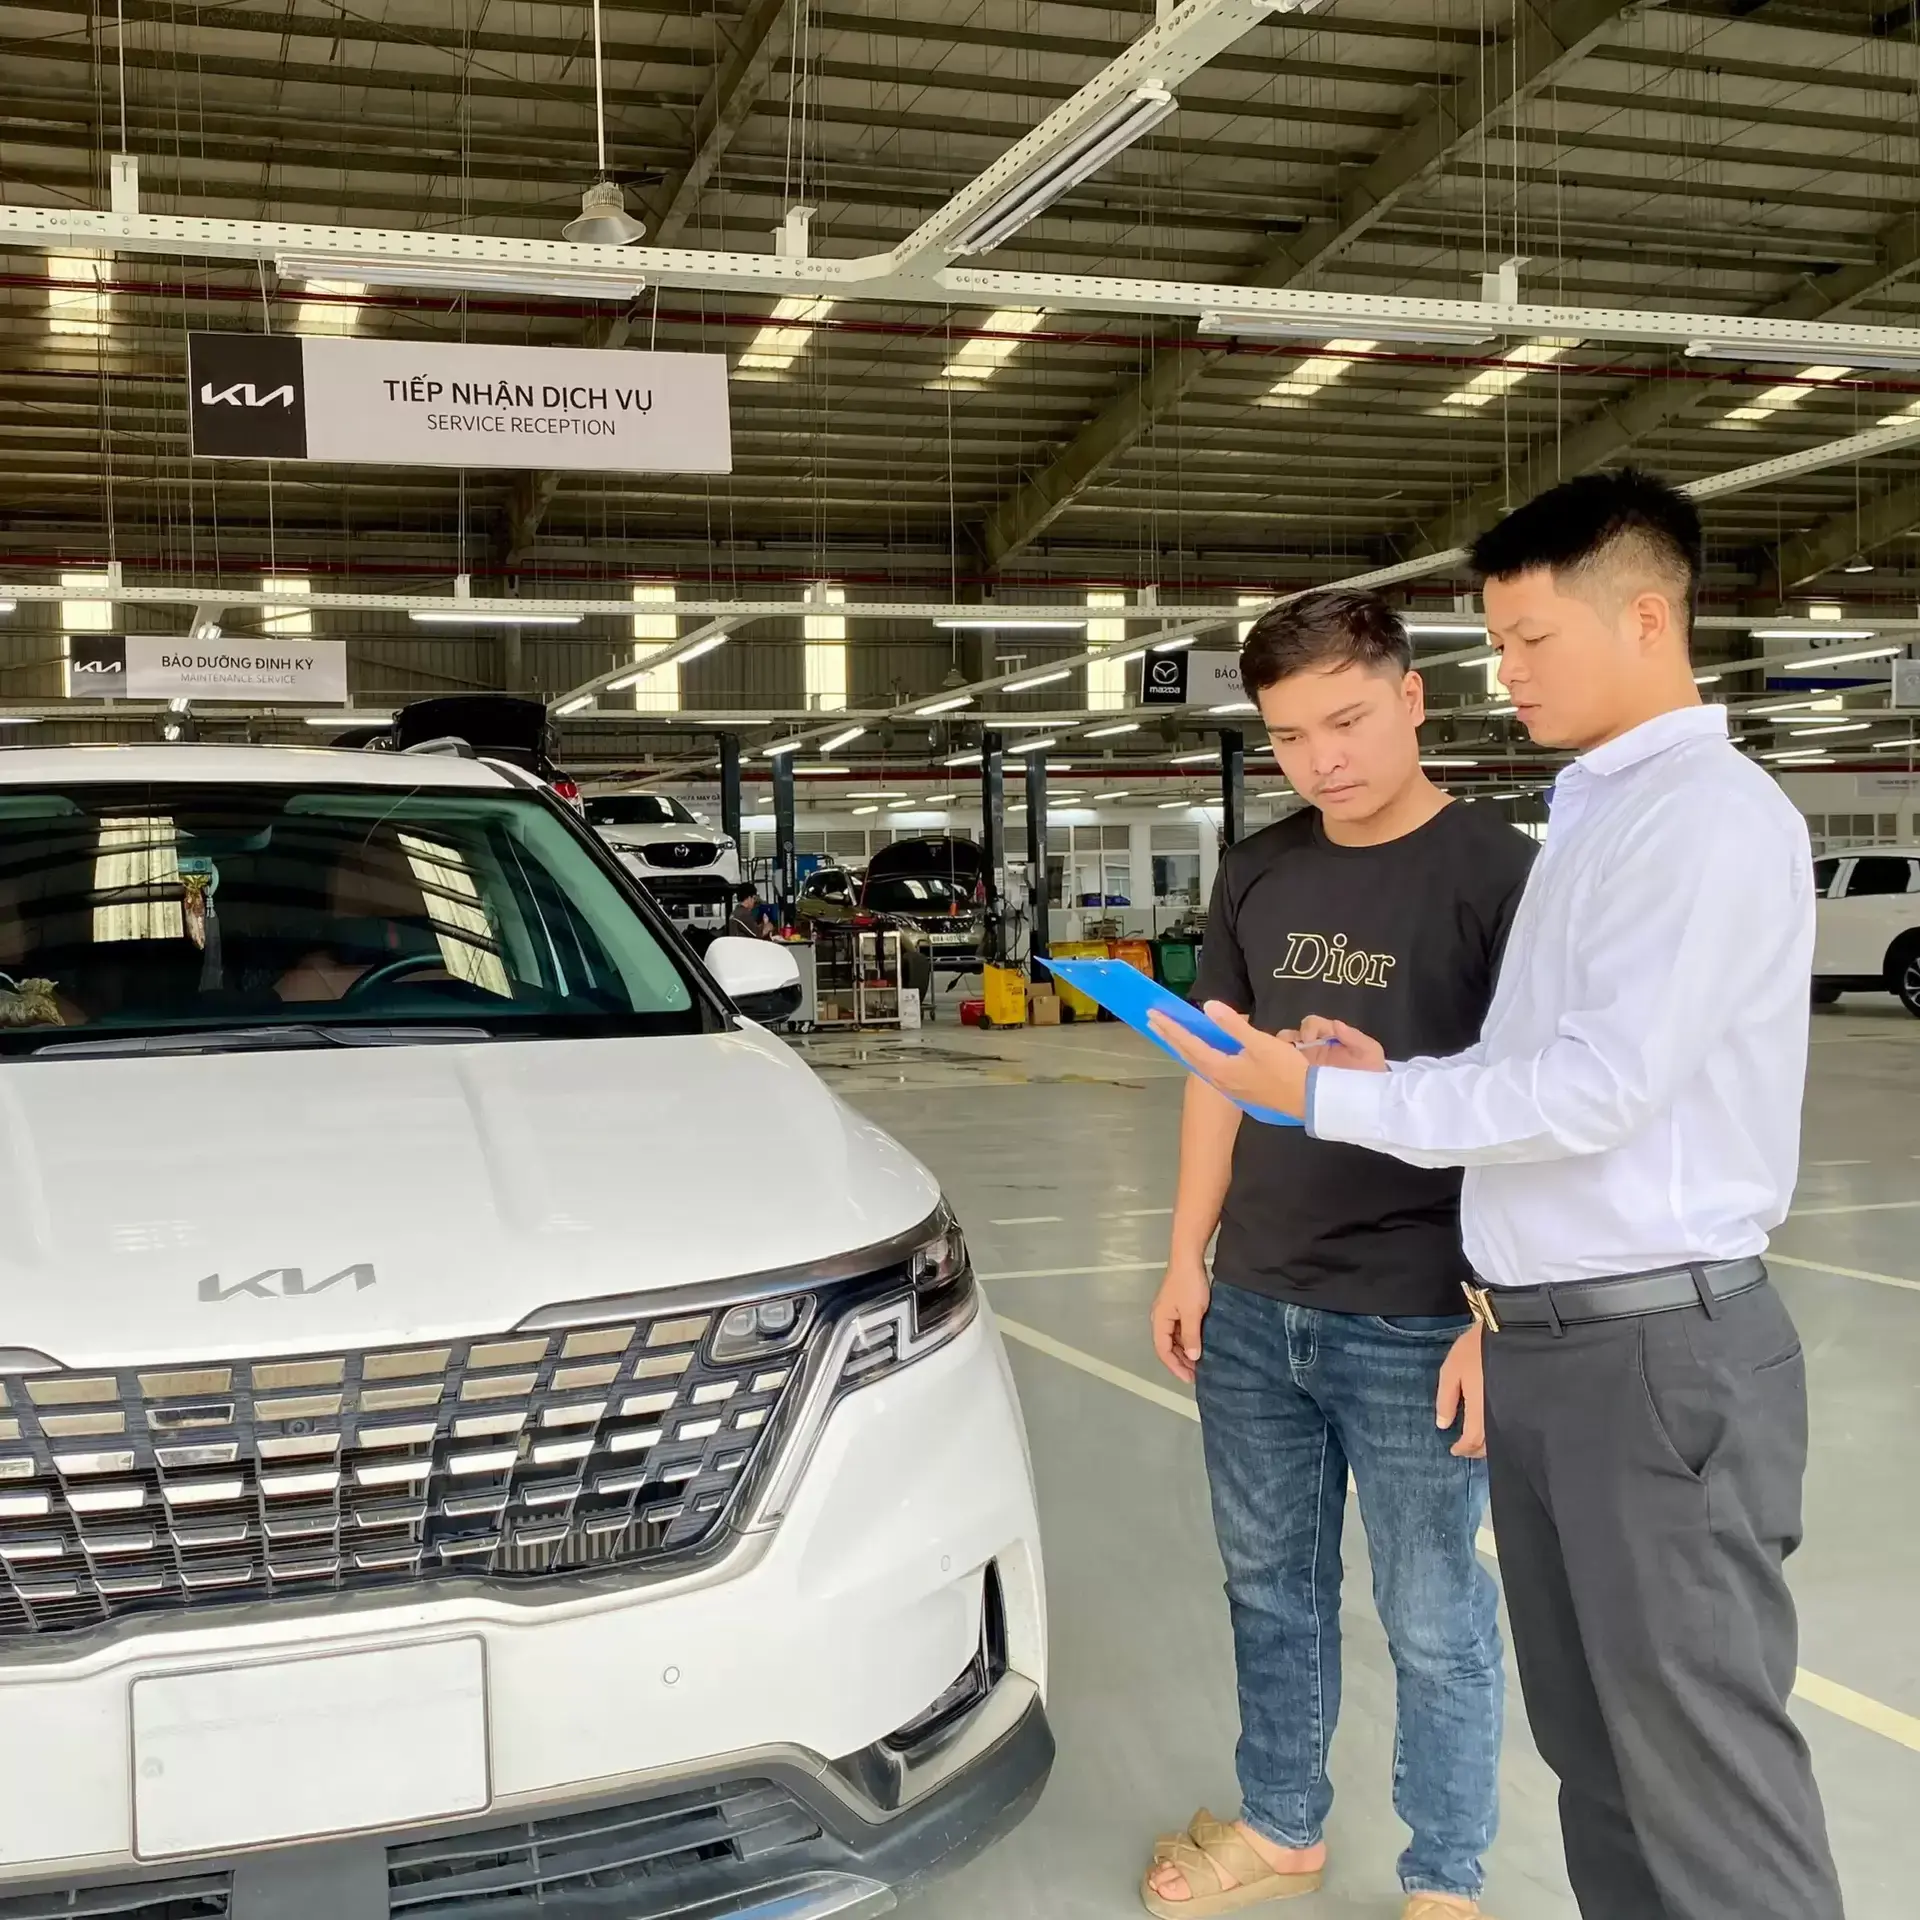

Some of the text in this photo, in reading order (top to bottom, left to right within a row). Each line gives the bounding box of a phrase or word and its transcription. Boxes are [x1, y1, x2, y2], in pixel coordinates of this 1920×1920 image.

[383, 374, 652, 416] TIẾP NHẬN DỊCH VỤ
[427, 414, 616, 435] SERVICE RECEPTION
[161, 653, 193, 668] BẢO
[197, 655, 251, 669] DƯỠNG
[255, 657, 291, 672] ĐỊNH
[1214, 664, 1238, 679] BẢO
[181, 673, 297, 684] MAINTENANCE SERVICE
[1149, 686, 1181, 694] mazda
[1273, 933, 1396, 988] Dior
